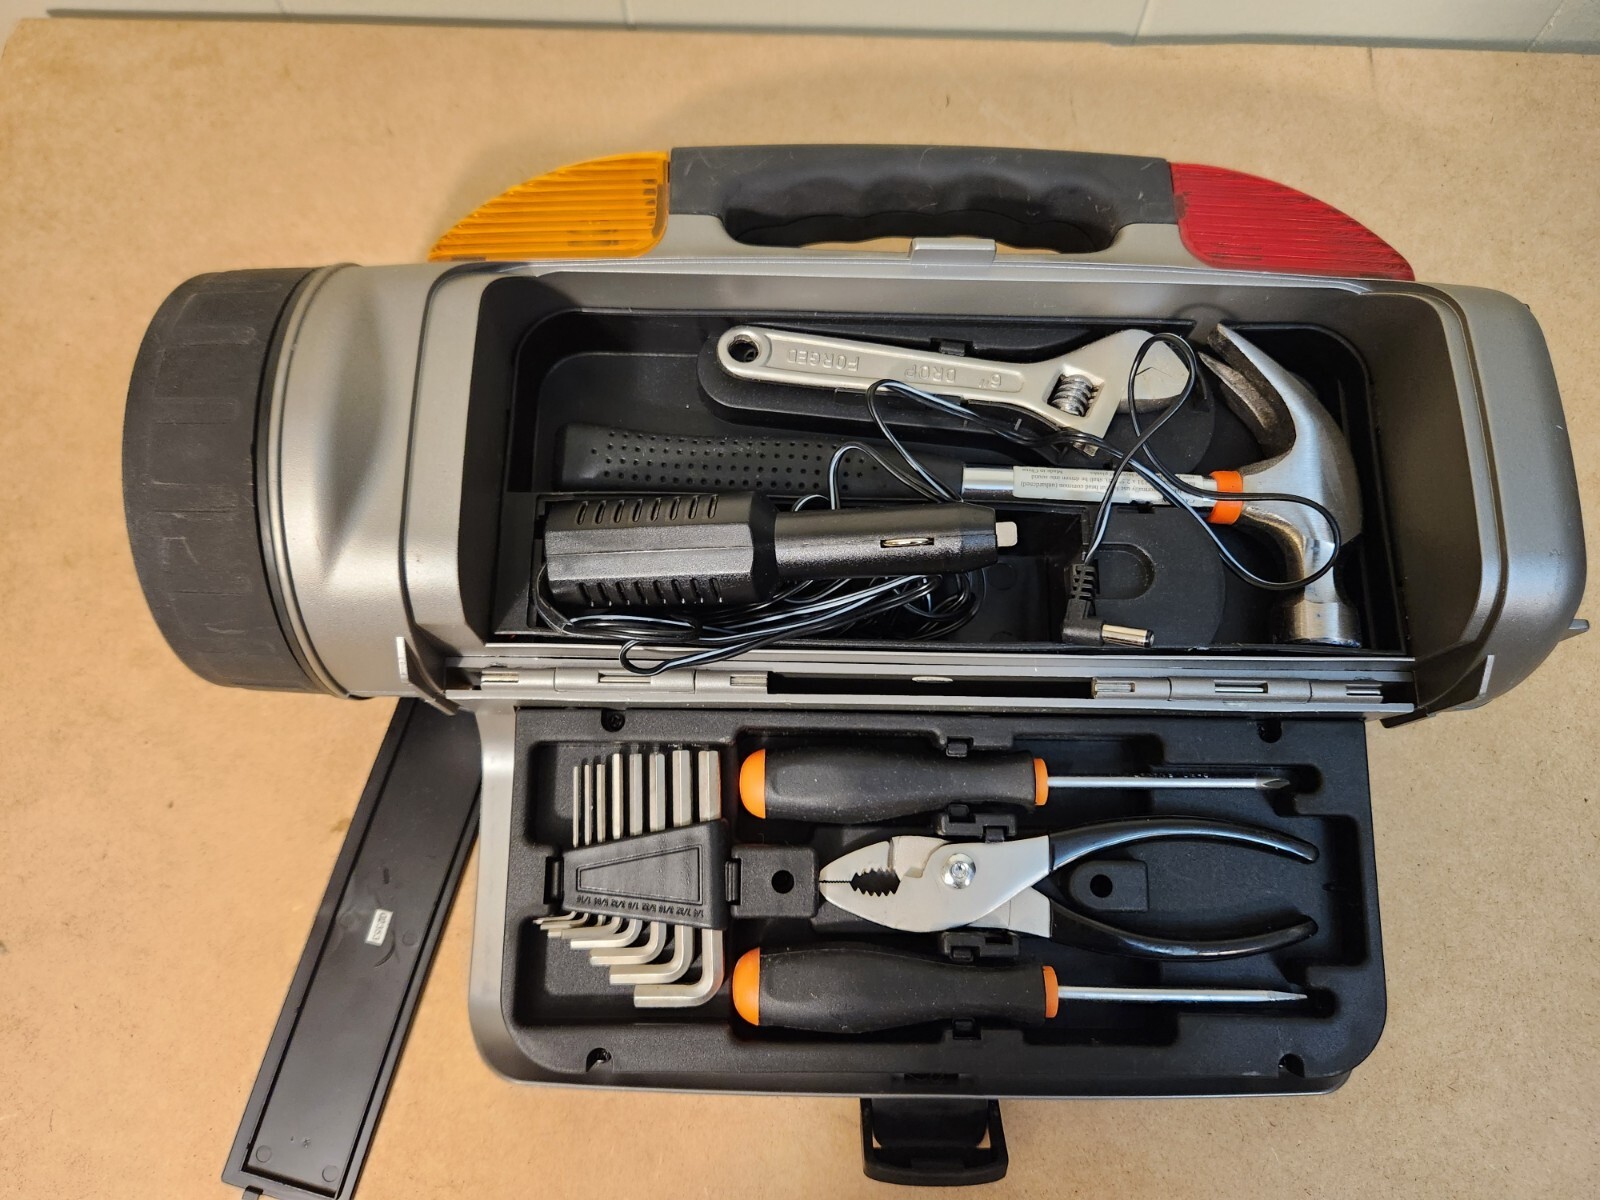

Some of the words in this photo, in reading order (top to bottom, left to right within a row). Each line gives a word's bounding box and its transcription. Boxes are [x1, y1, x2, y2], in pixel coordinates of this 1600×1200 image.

[787, 348, 859, 373] FORGED
[904, 363, 956, 385] DROP
[978, 372, 1002, 390] 6"
[1020, 480, 1057, 489] (unhardened)
